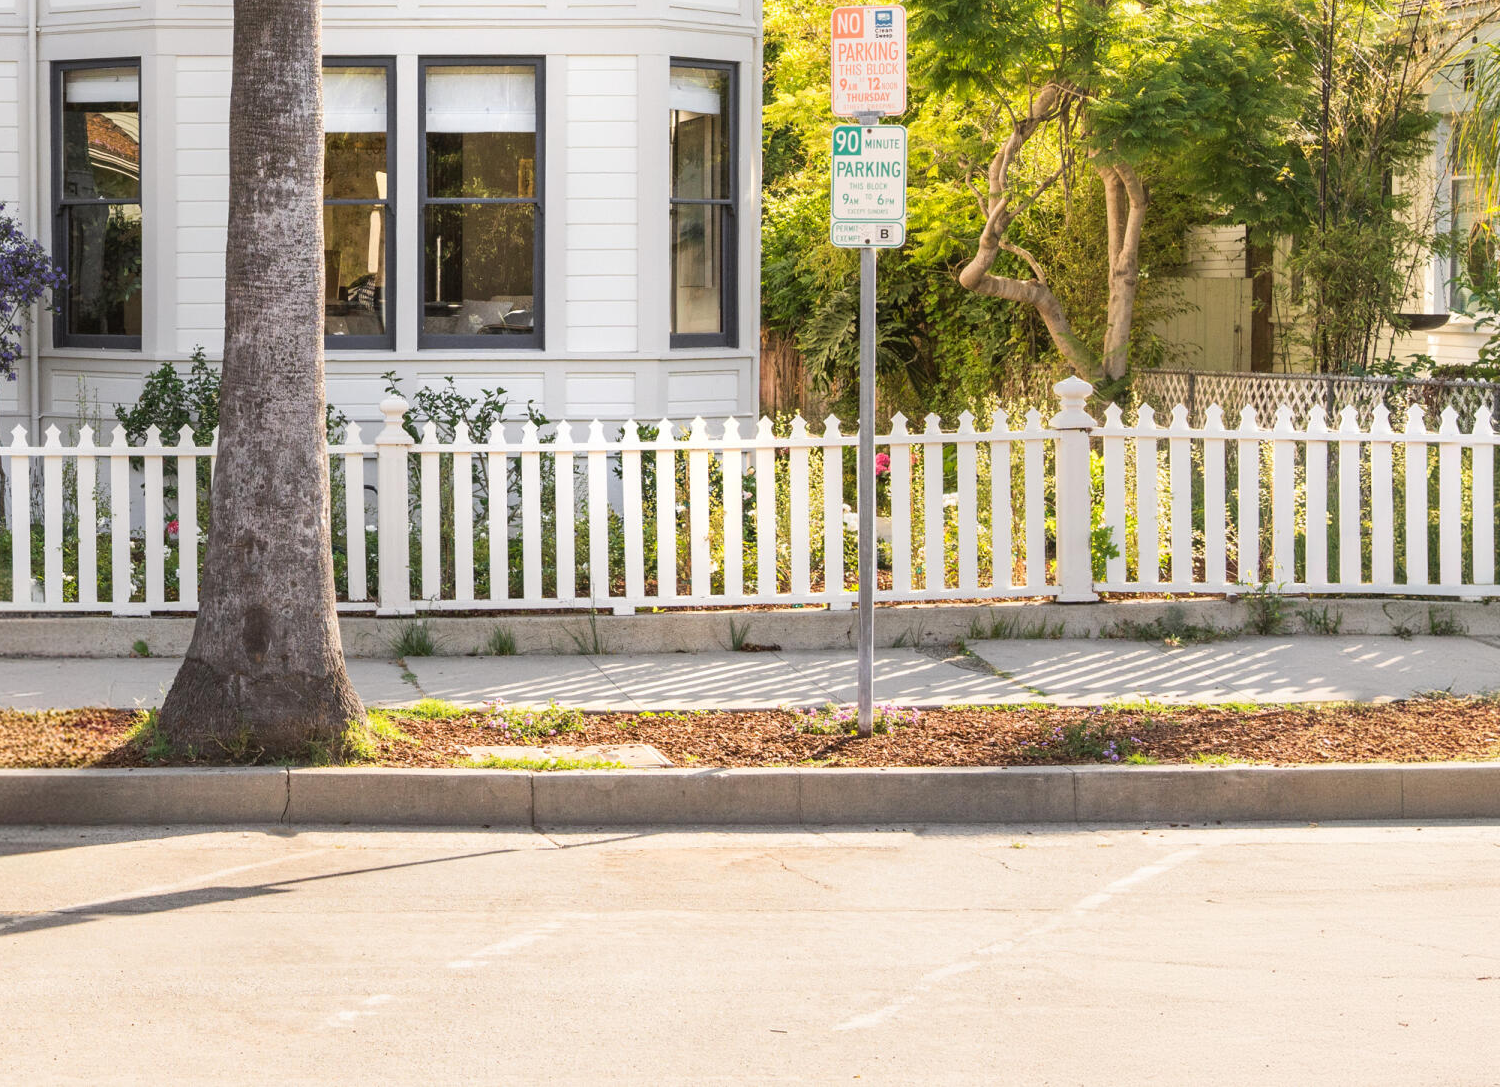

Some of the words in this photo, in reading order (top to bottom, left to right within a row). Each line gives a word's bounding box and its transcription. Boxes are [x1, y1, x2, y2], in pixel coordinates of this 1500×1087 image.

[837, 12, 861, 34] NO
[838, 41, 899, 62] PARKING
[838, 64, 862, 76] THIS
[866, 63, 899, 75] BLOCK
[846, 92, 891, 103] THURSDAY
[835, 130, 859, 153] 90
[865, 138, 900, 149] MINUTE
[837, 161, 901, 178] PARKING
[849, 182, 864, 190] THIS
[866, 182, 887, 190] BLOCK
[880, 229, 889, 239] B
